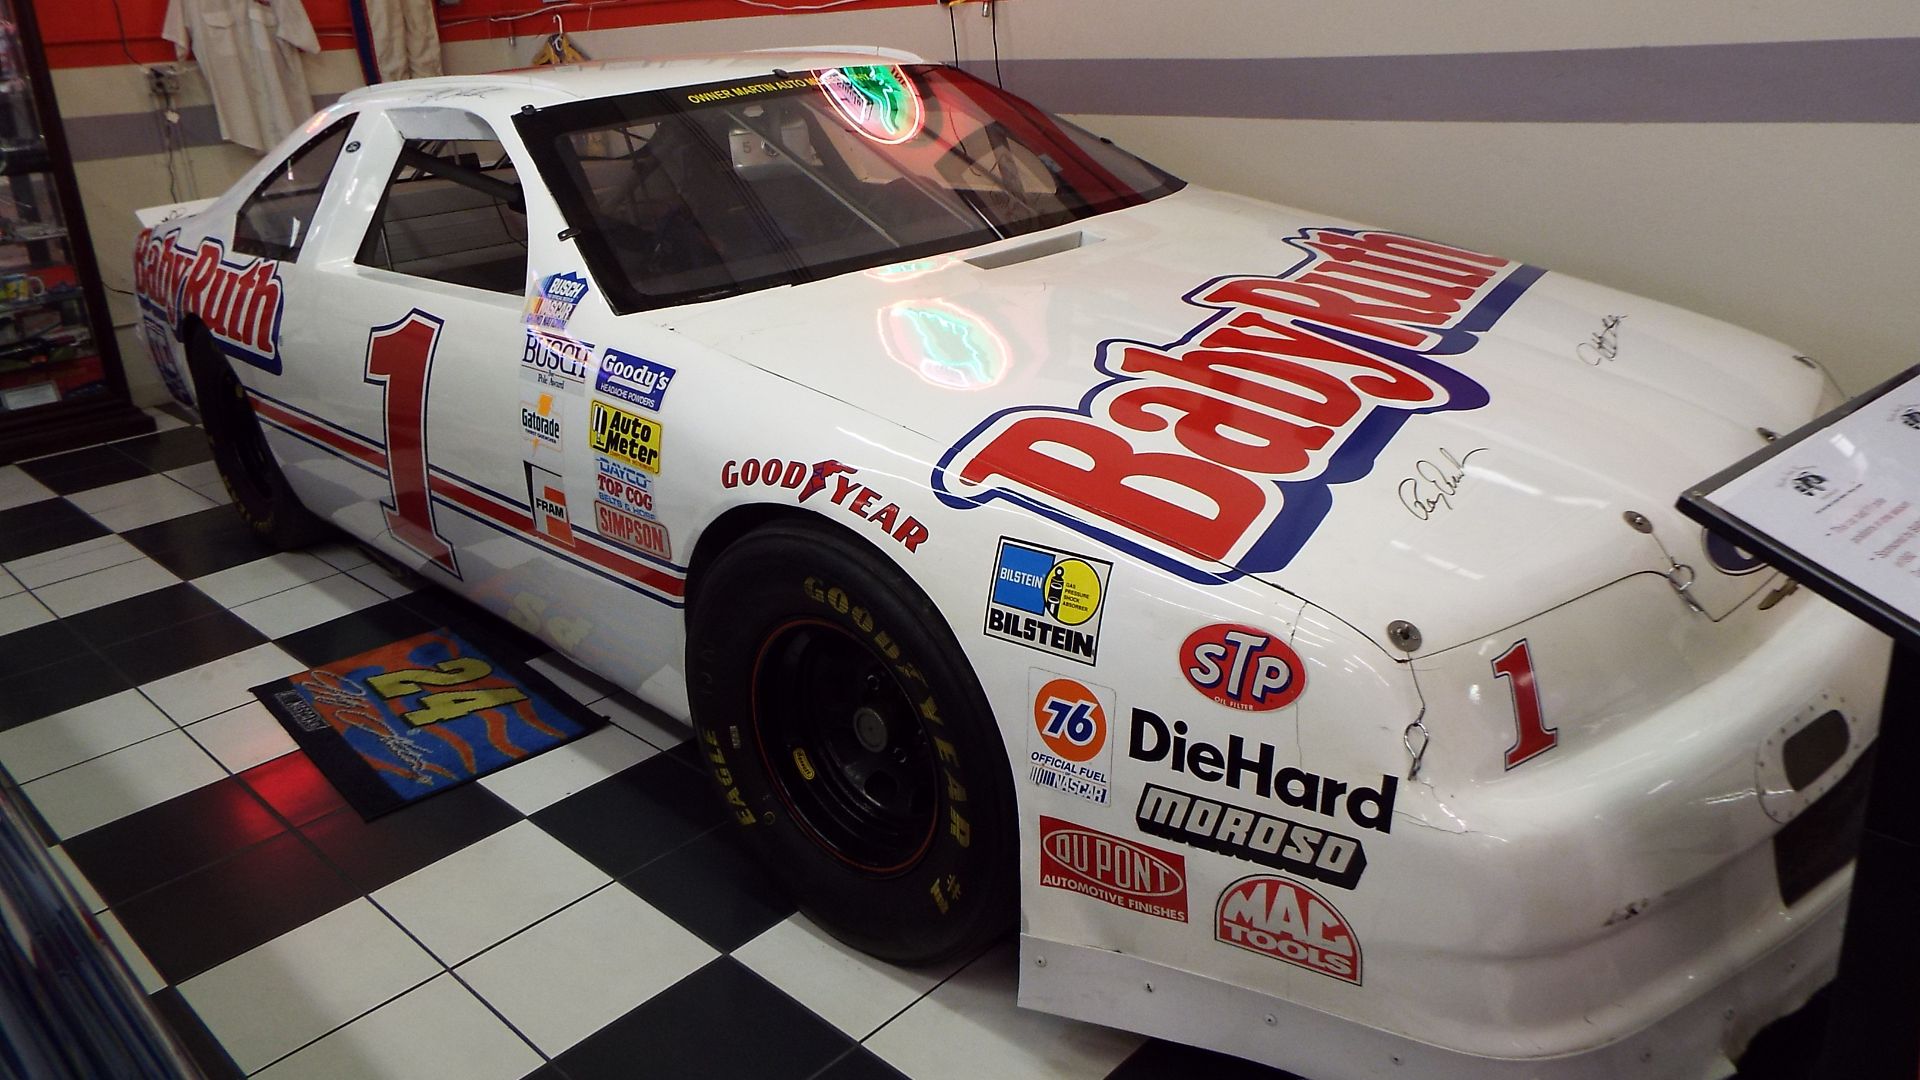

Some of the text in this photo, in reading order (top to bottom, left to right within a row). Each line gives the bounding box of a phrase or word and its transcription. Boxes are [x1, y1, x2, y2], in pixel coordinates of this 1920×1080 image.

[687, 89, 735, 104] OWNER
[731, 82, 777, 97] MARTIN
[775, 79, 807, 90] AUTO
[548, 277, 586, 299] BUSCH
[521, 333, 591, 379] BUSCH
[602, 354, 670, 394] Goody's
[600, 382, 656, 409] HEADACHE POWDERS
[521, 407, 560, 440] Gatorade
[609, 410, 652, 443] Auto
[364, 308, 463, 581] 1
[606, 432, 658, 466] Meter
[596, 457, 652, 489] DAYCO
[535, 497, 565, 519] FRAM
[597, 473, 653, 511] TOP COG
[599, 506, 665, 553] SIMPSON
[1000, 566, 1044, 590] BILSTEIN
[1064, 588, 1090, 600] PRESSURE
[1065, 582, 1076, 590] GAS
[1062, 600, 1089, 612] ABSORBER
[1063, 594, 1080, 604] SHOCK
[988, 607, 1095, 659] BILSTEIN
[1188, 630, 1293, 704] STP
[365, 656, 529, 728] 24
[1214, 695, 1254, 711] OIL FILTER
[1490, 638, 1558, 772] 1
[1045, 699, 1097, 744] 76
[1031, 751, 1107, 783] OFFICIAL FUEL
[1128, 706, 1399, 834] DieHard
[1053, 773, 1107, 804] NASCAR
[1138, 784, 1360, 877] MOROSO
[1042, 873, 1187, 923] AUTOMOTIVE FINISHES
[1223, 881, 1353, 957] MAC
[1223, 919, 1353, 976] TOOLS
